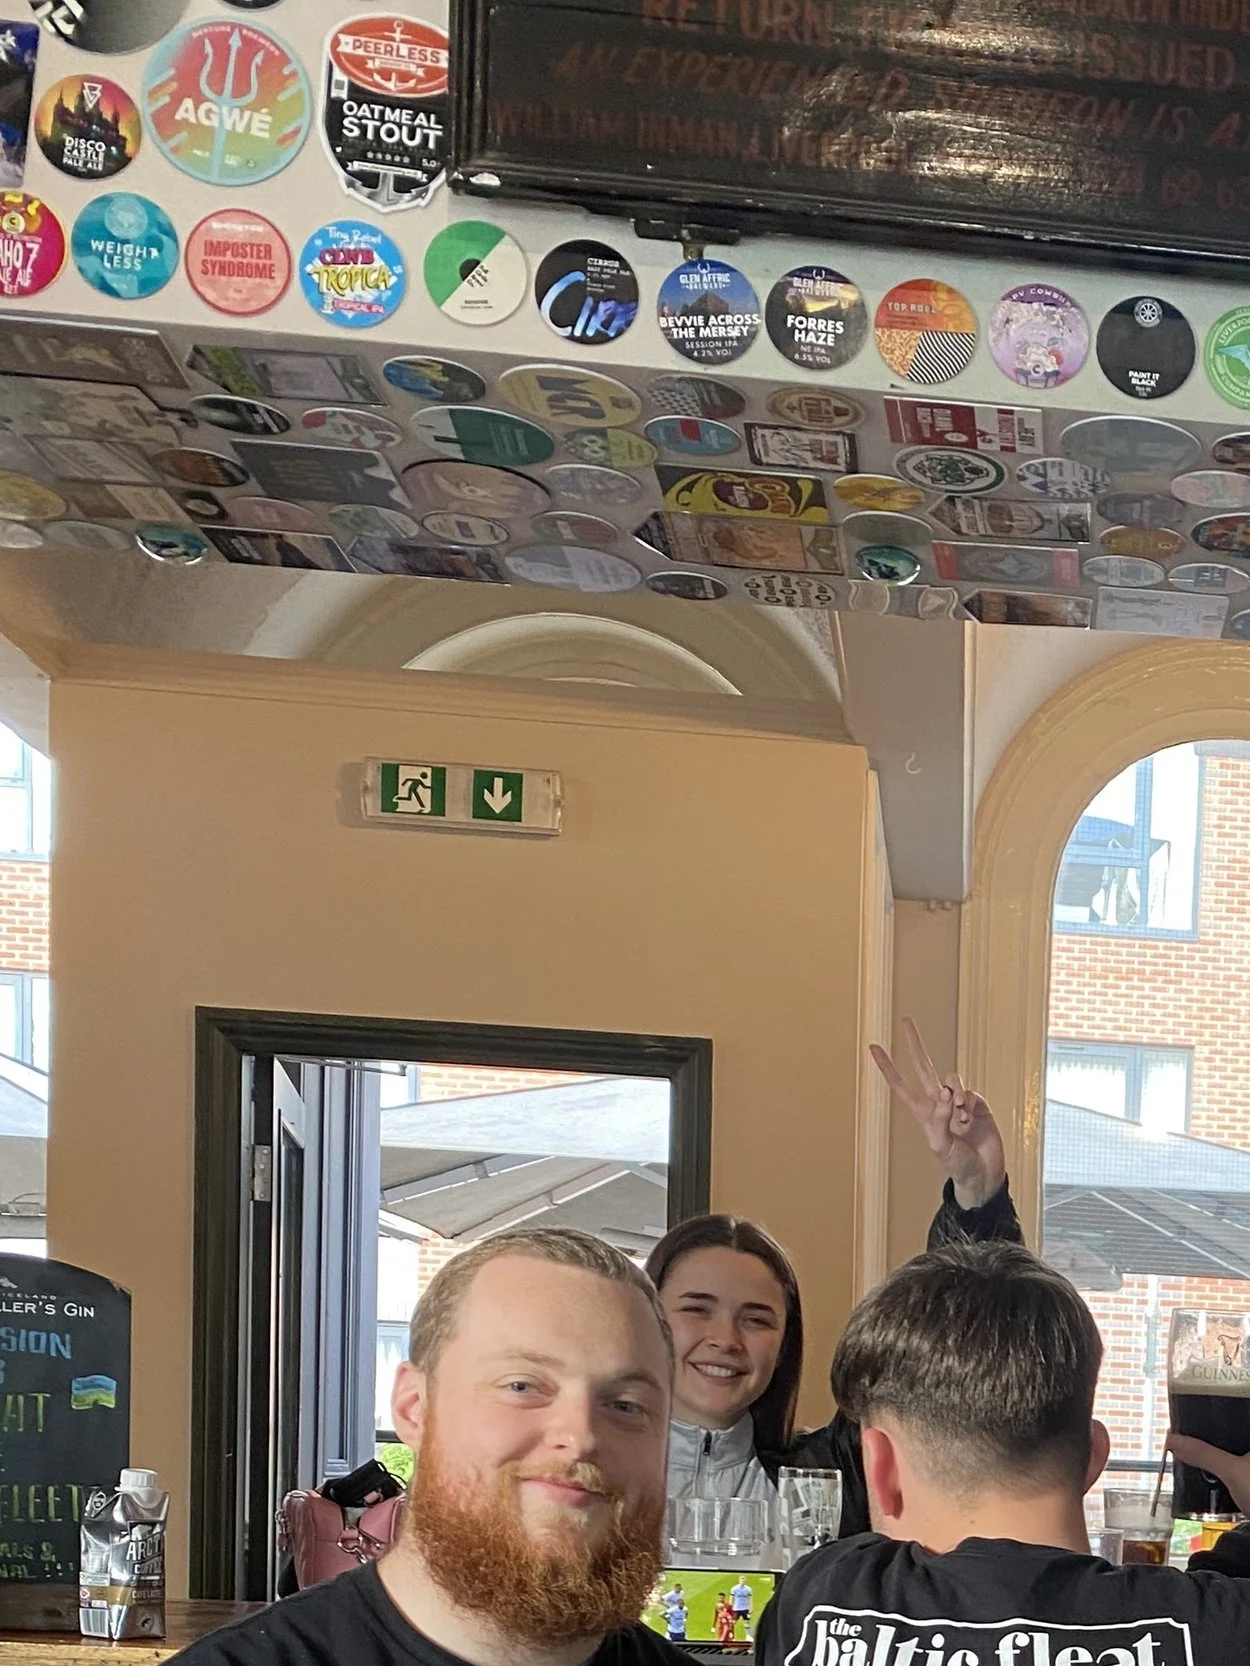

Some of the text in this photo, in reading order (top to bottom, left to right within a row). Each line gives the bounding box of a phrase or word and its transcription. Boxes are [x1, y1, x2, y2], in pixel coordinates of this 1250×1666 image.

[351, 38, 440, 64] PEERLESS
[174, 97, 273, 138] AGWÉ
[342, 100, 443, 129] OATMEAL
[65, 136, 106, 151] DISCO
[342, 117, 443, 149] STOUT
[203, 239, 272, 261] IMPOSTER
[102, 255, 143, 272] LESS
[200, 258, 276, 280] SYNDROME
[659, 314, 758, 328] BEVVIE ACROSS
[672, 326, 749, 338] THE MERSEY
[786, 314, 844, 334] FORRES
[794, 328, 835, 346] HAZE
[829, 1617, 863, 1639] the
